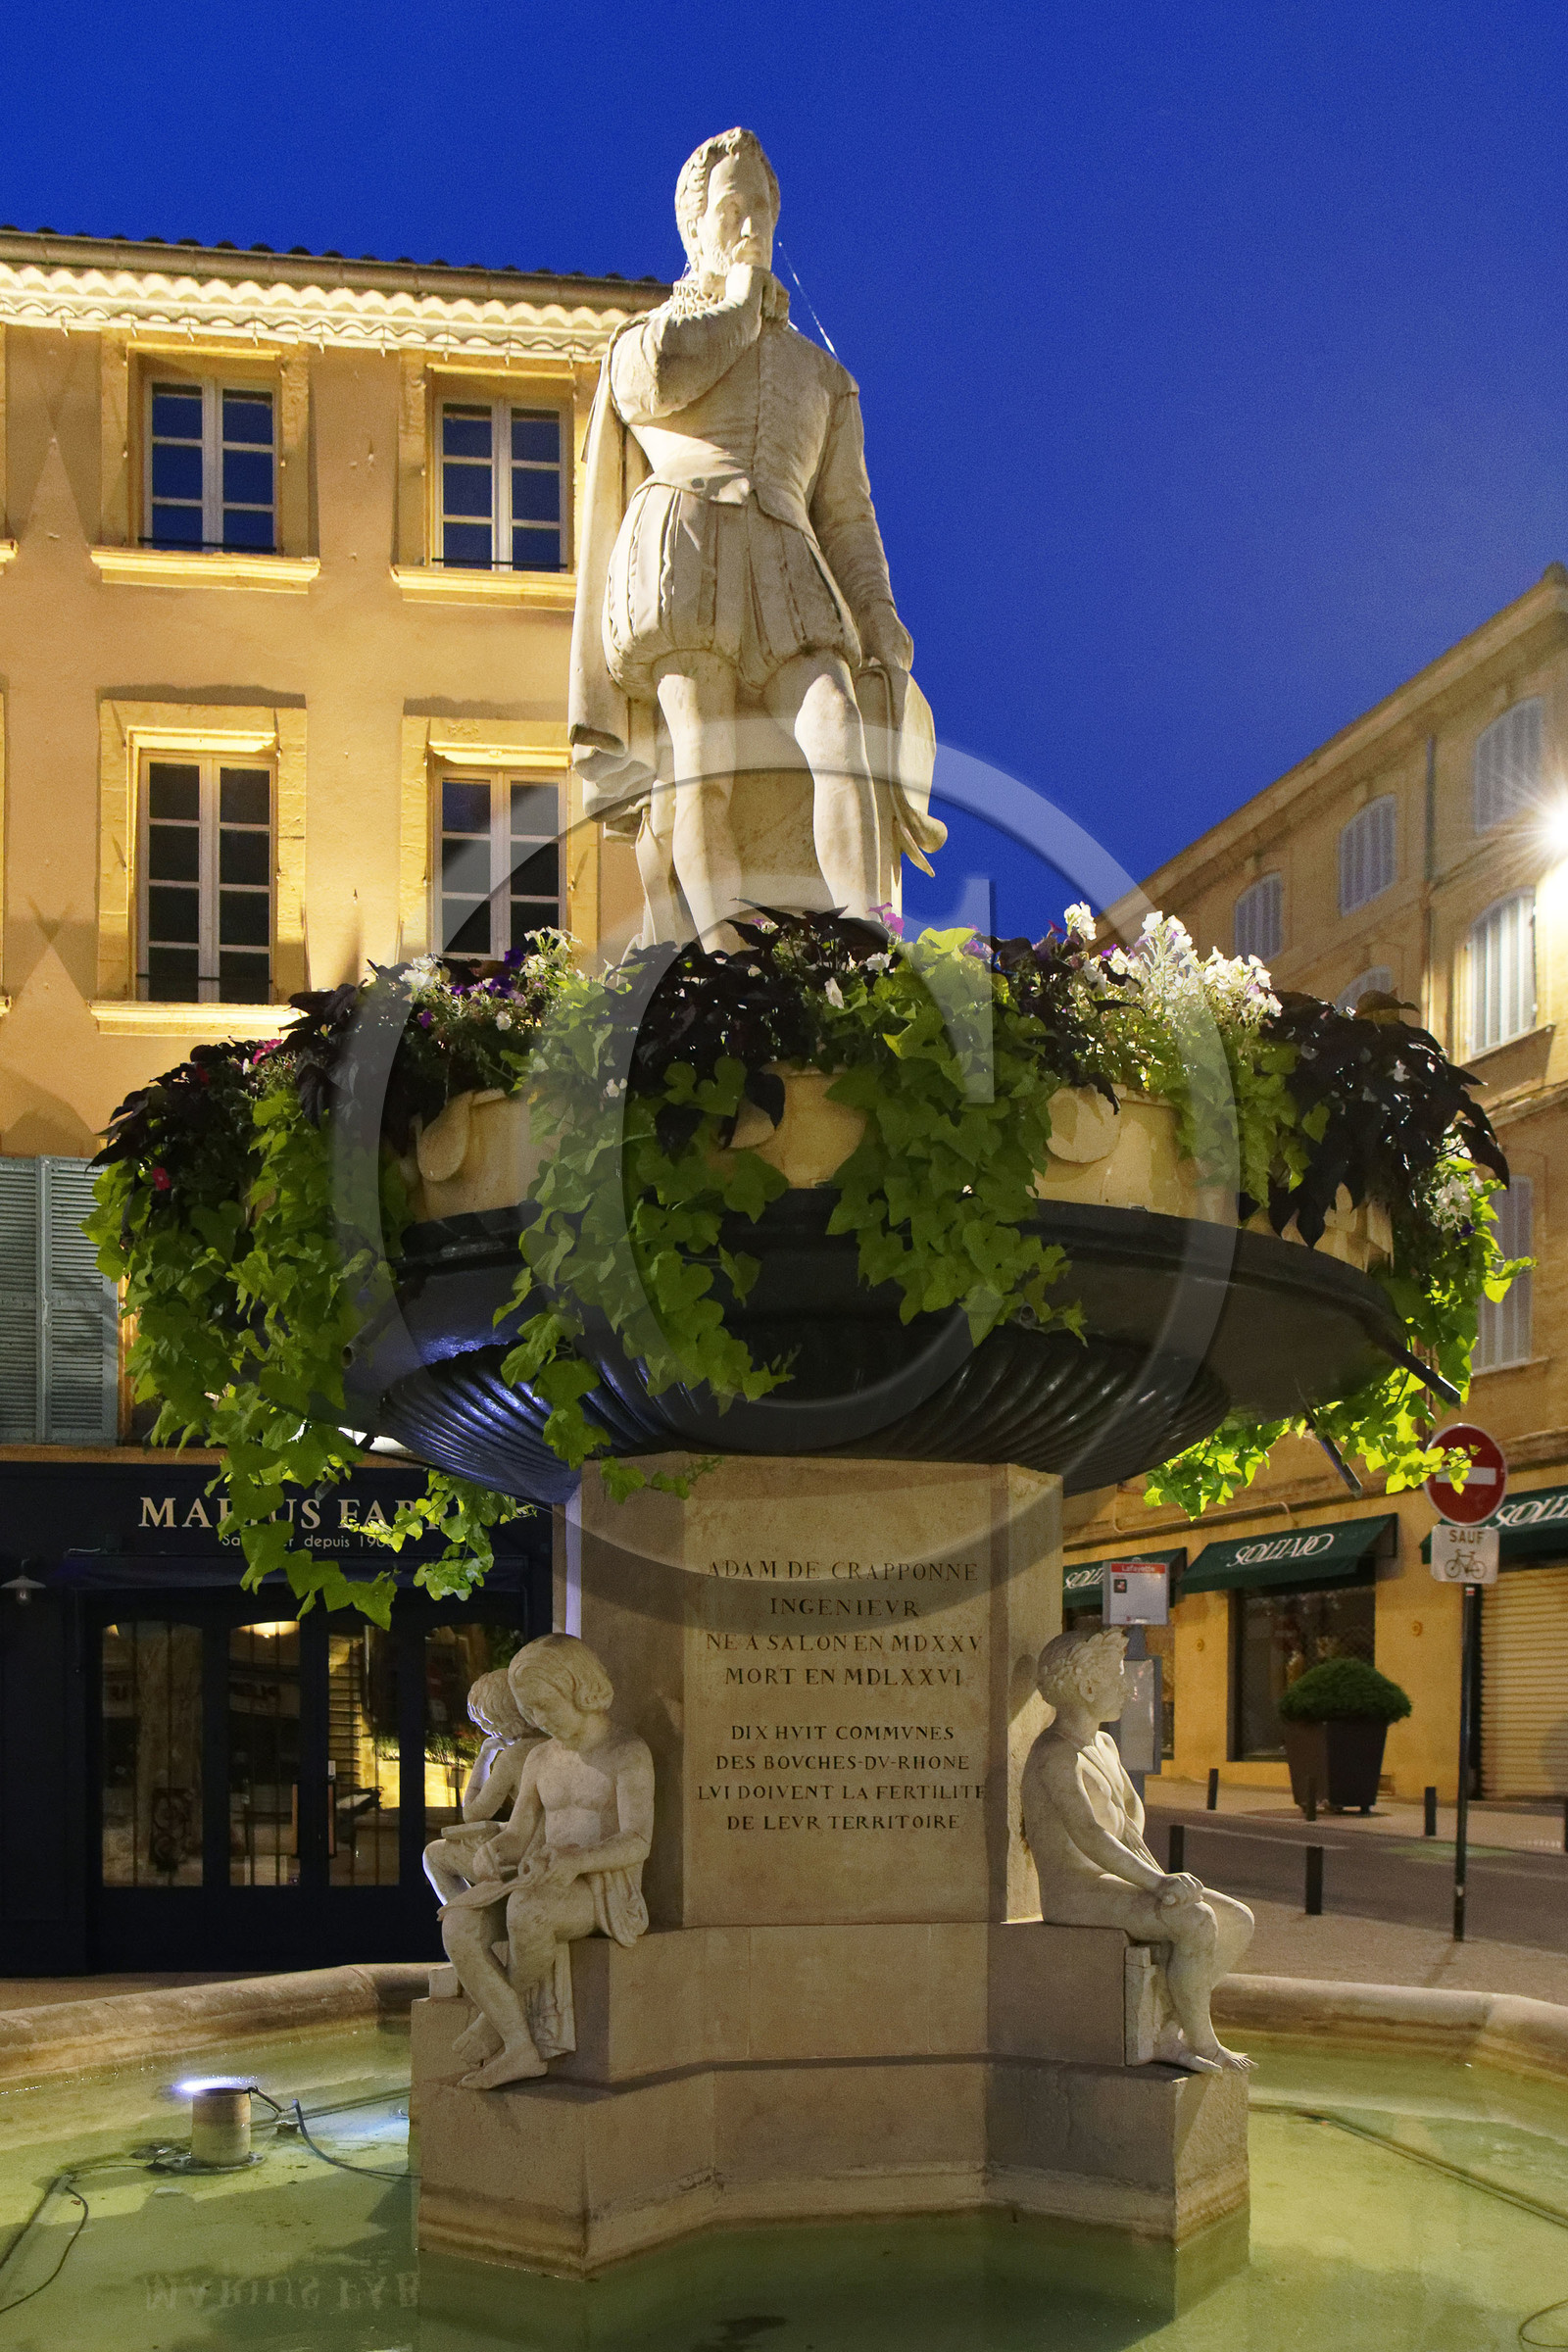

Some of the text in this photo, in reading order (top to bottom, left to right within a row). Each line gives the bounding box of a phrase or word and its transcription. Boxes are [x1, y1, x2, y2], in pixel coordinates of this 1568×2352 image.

[304, 1534, 350, 1549] depuis
[360, 1535, 393, 1548] 190
[1448, 1530, 1485, 1544] SAUF
[707, 1559, 978, 1581] ADAM DE CRAPPONNE
[770, 1597, 919, 1617] INGENIEVR
[706, 1633, 738, 1650] NE
[766, 1635, 847, 1651] SALON
[855, 1636, 883, 1651] EN
[891, 1635, 983, 1652] MDXXV
[725, 1667, 961, 1686] MORT EN MDLXXVI
[731, 1725, 955, 1740] DIX HVIT COMMVNES
[716, 1755, 756, 1770] DES
[698, 1785, 987, 1800] LVI DOIVENT LA FERTILITE
[727, 1814, 960, 1831] DE LEVR TERRITOIRE
